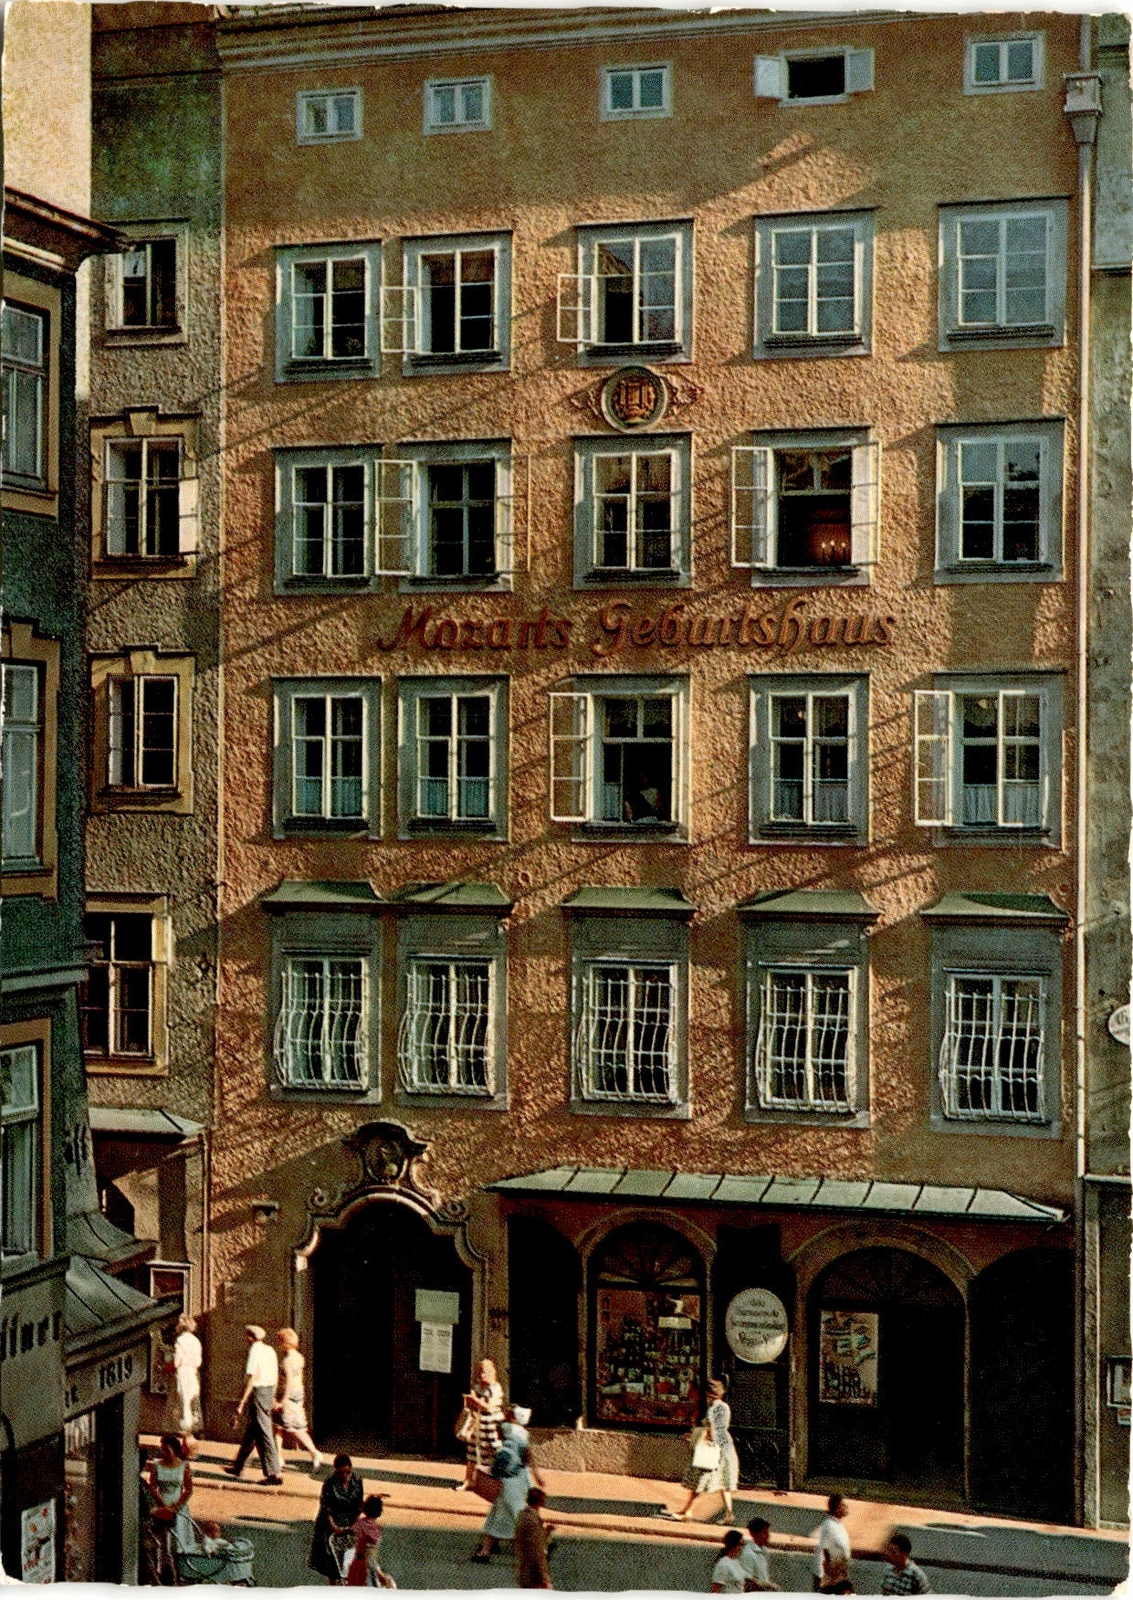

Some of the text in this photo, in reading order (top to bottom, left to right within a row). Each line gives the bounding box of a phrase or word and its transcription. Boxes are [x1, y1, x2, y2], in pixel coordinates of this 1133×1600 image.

[377, 600, 896, 657] Mozarts Geburtshaus
[99, 1354, 133, 1390] 1819
